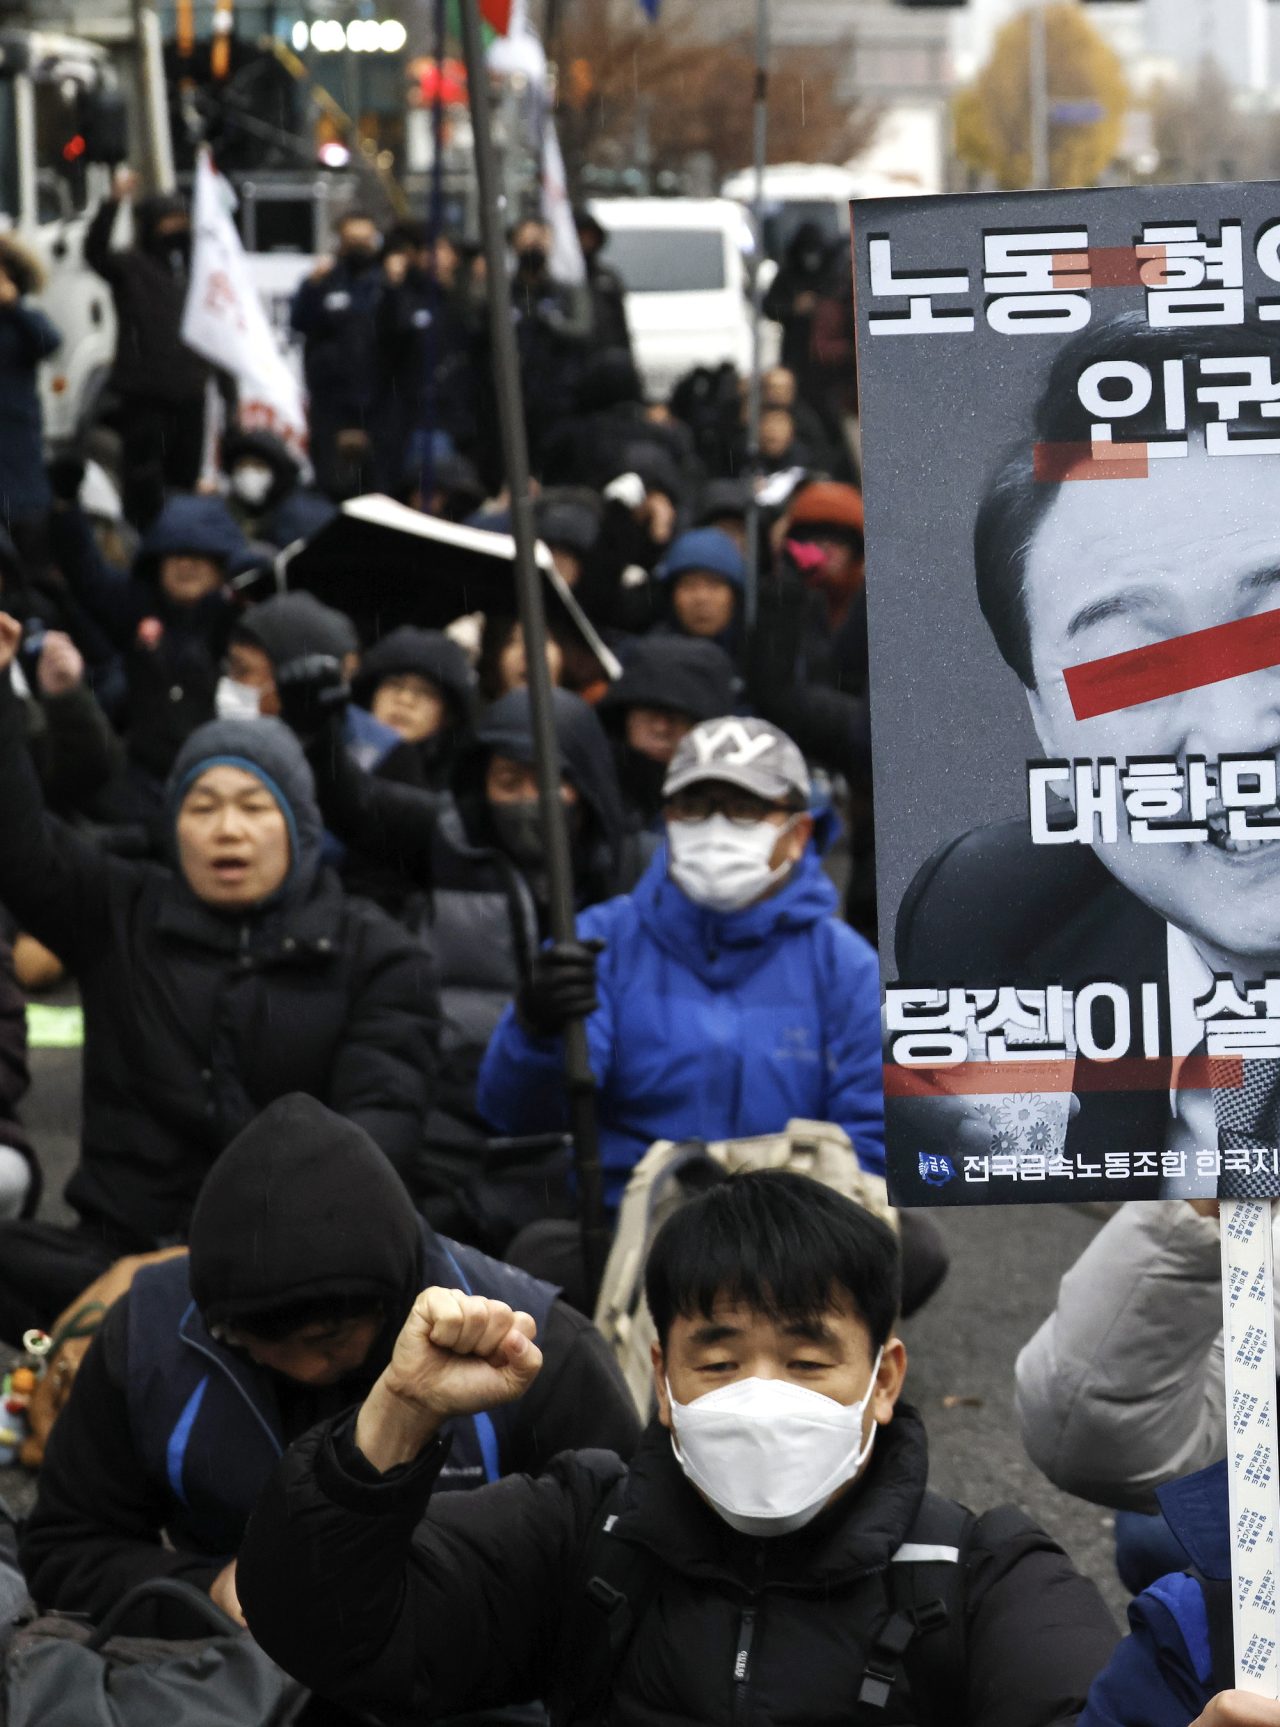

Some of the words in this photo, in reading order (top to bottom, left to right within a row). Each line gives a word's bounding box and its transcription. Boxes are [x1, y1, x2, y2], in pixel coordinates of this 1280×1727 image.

[868, 229, 1092, 335] 노동
[884, 981, 1163, 1067] 당신이
[963, 1149, 1188, 1183] 전국금속노동조합
